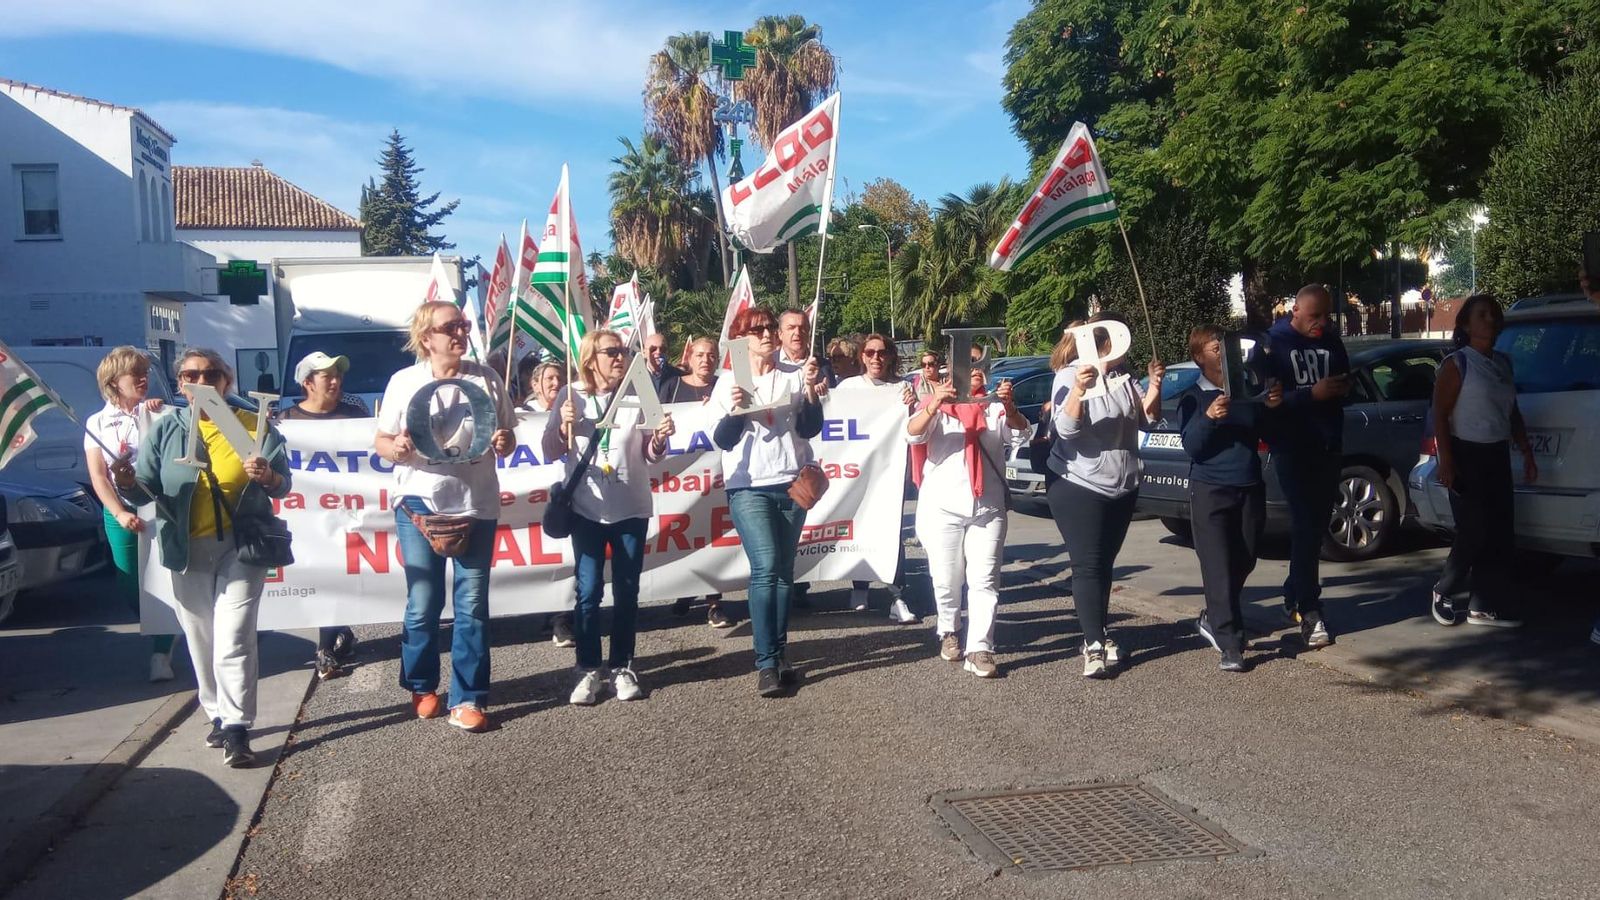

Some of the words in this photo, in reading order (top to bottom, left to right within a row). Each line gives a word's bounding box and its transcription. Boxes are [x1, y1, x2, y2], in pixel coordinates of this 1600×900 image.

[787, 155, 830, 194] Mála
[1049, 170, 1097, 202] Málaga
[941, 327, 1006, 404] E
[595, 352, 665, 430] A
[174, 383, 281, 468] N
[406, 379, 497, 464] O
[1149, 434, 1168, 447] 5500
[319, 493, 365, 510] en
[345, 531, 405, 575] N
[267, 586, 316, 598] málaga
